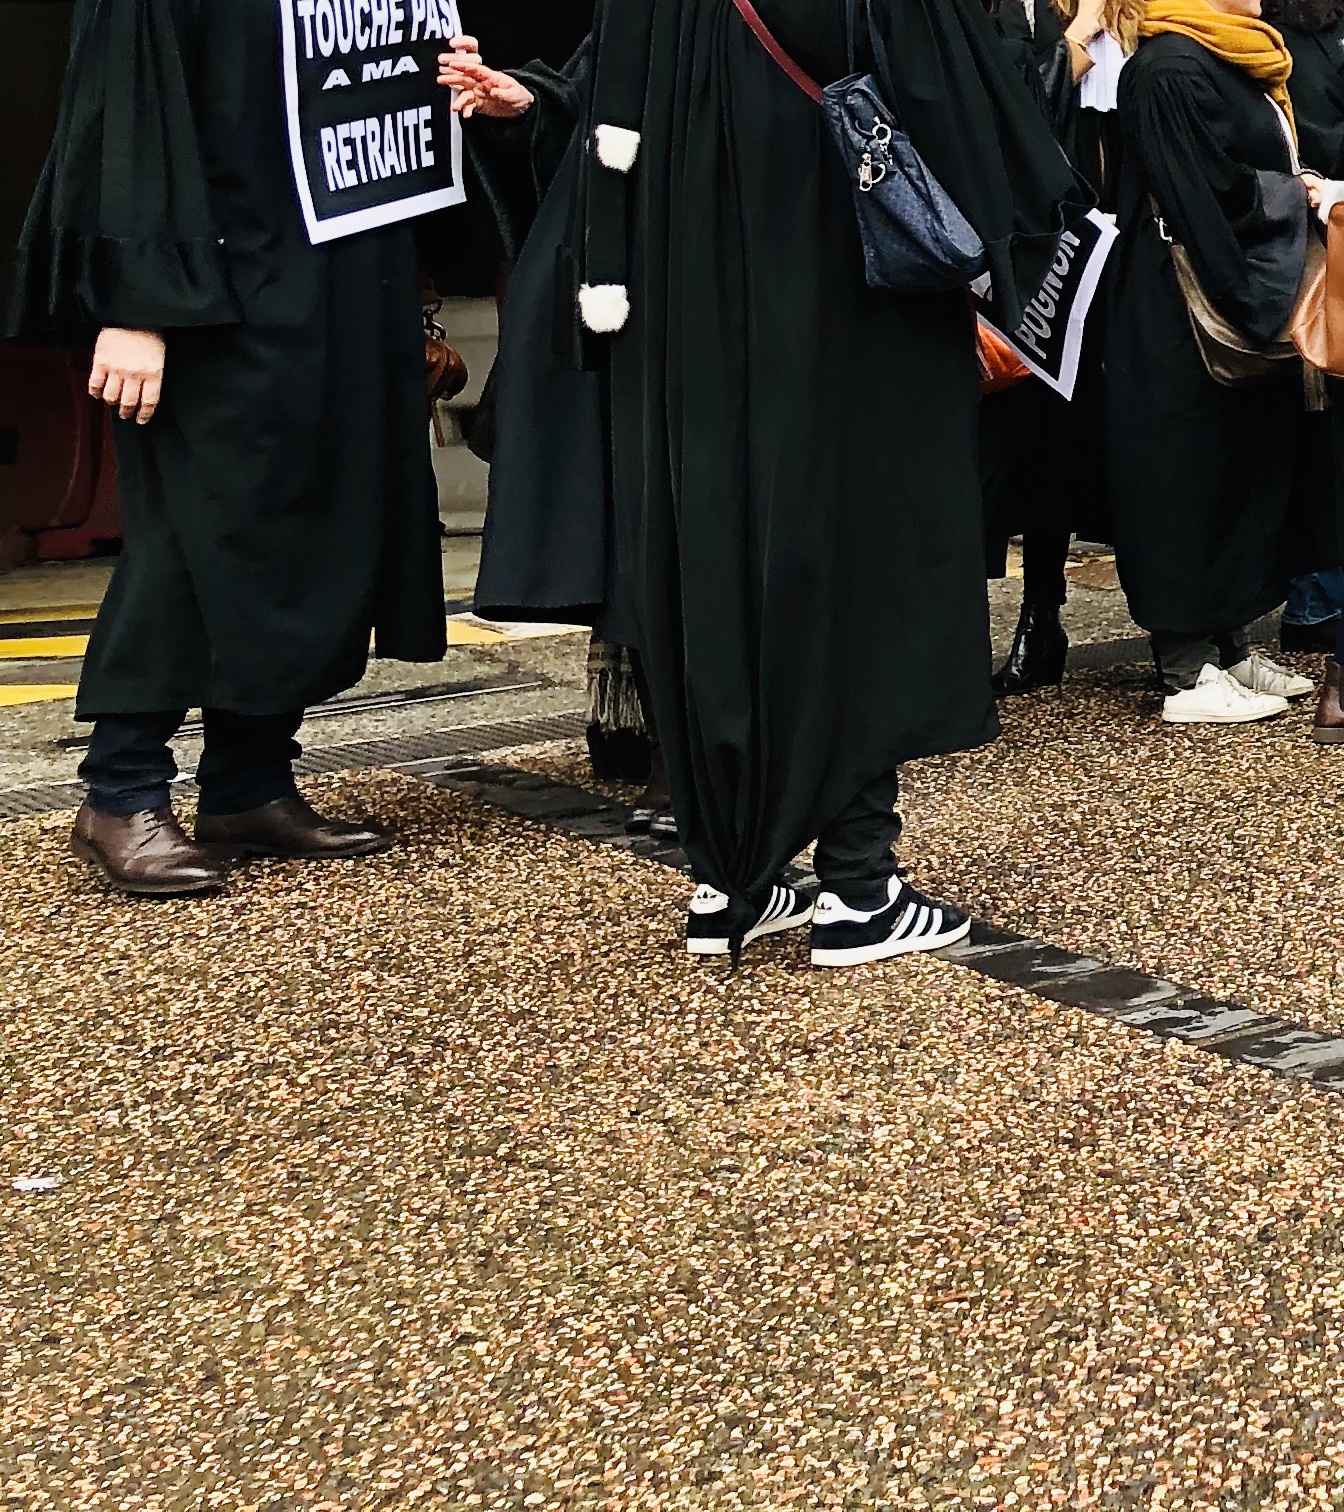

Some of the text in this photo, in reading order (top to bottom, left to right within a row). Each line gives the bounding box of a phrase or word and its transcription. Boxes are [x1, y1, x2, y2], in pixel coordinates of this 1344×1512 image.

[322, 55, 420, 90] A MA
[320, 105, 434, 192] RETRAITE
